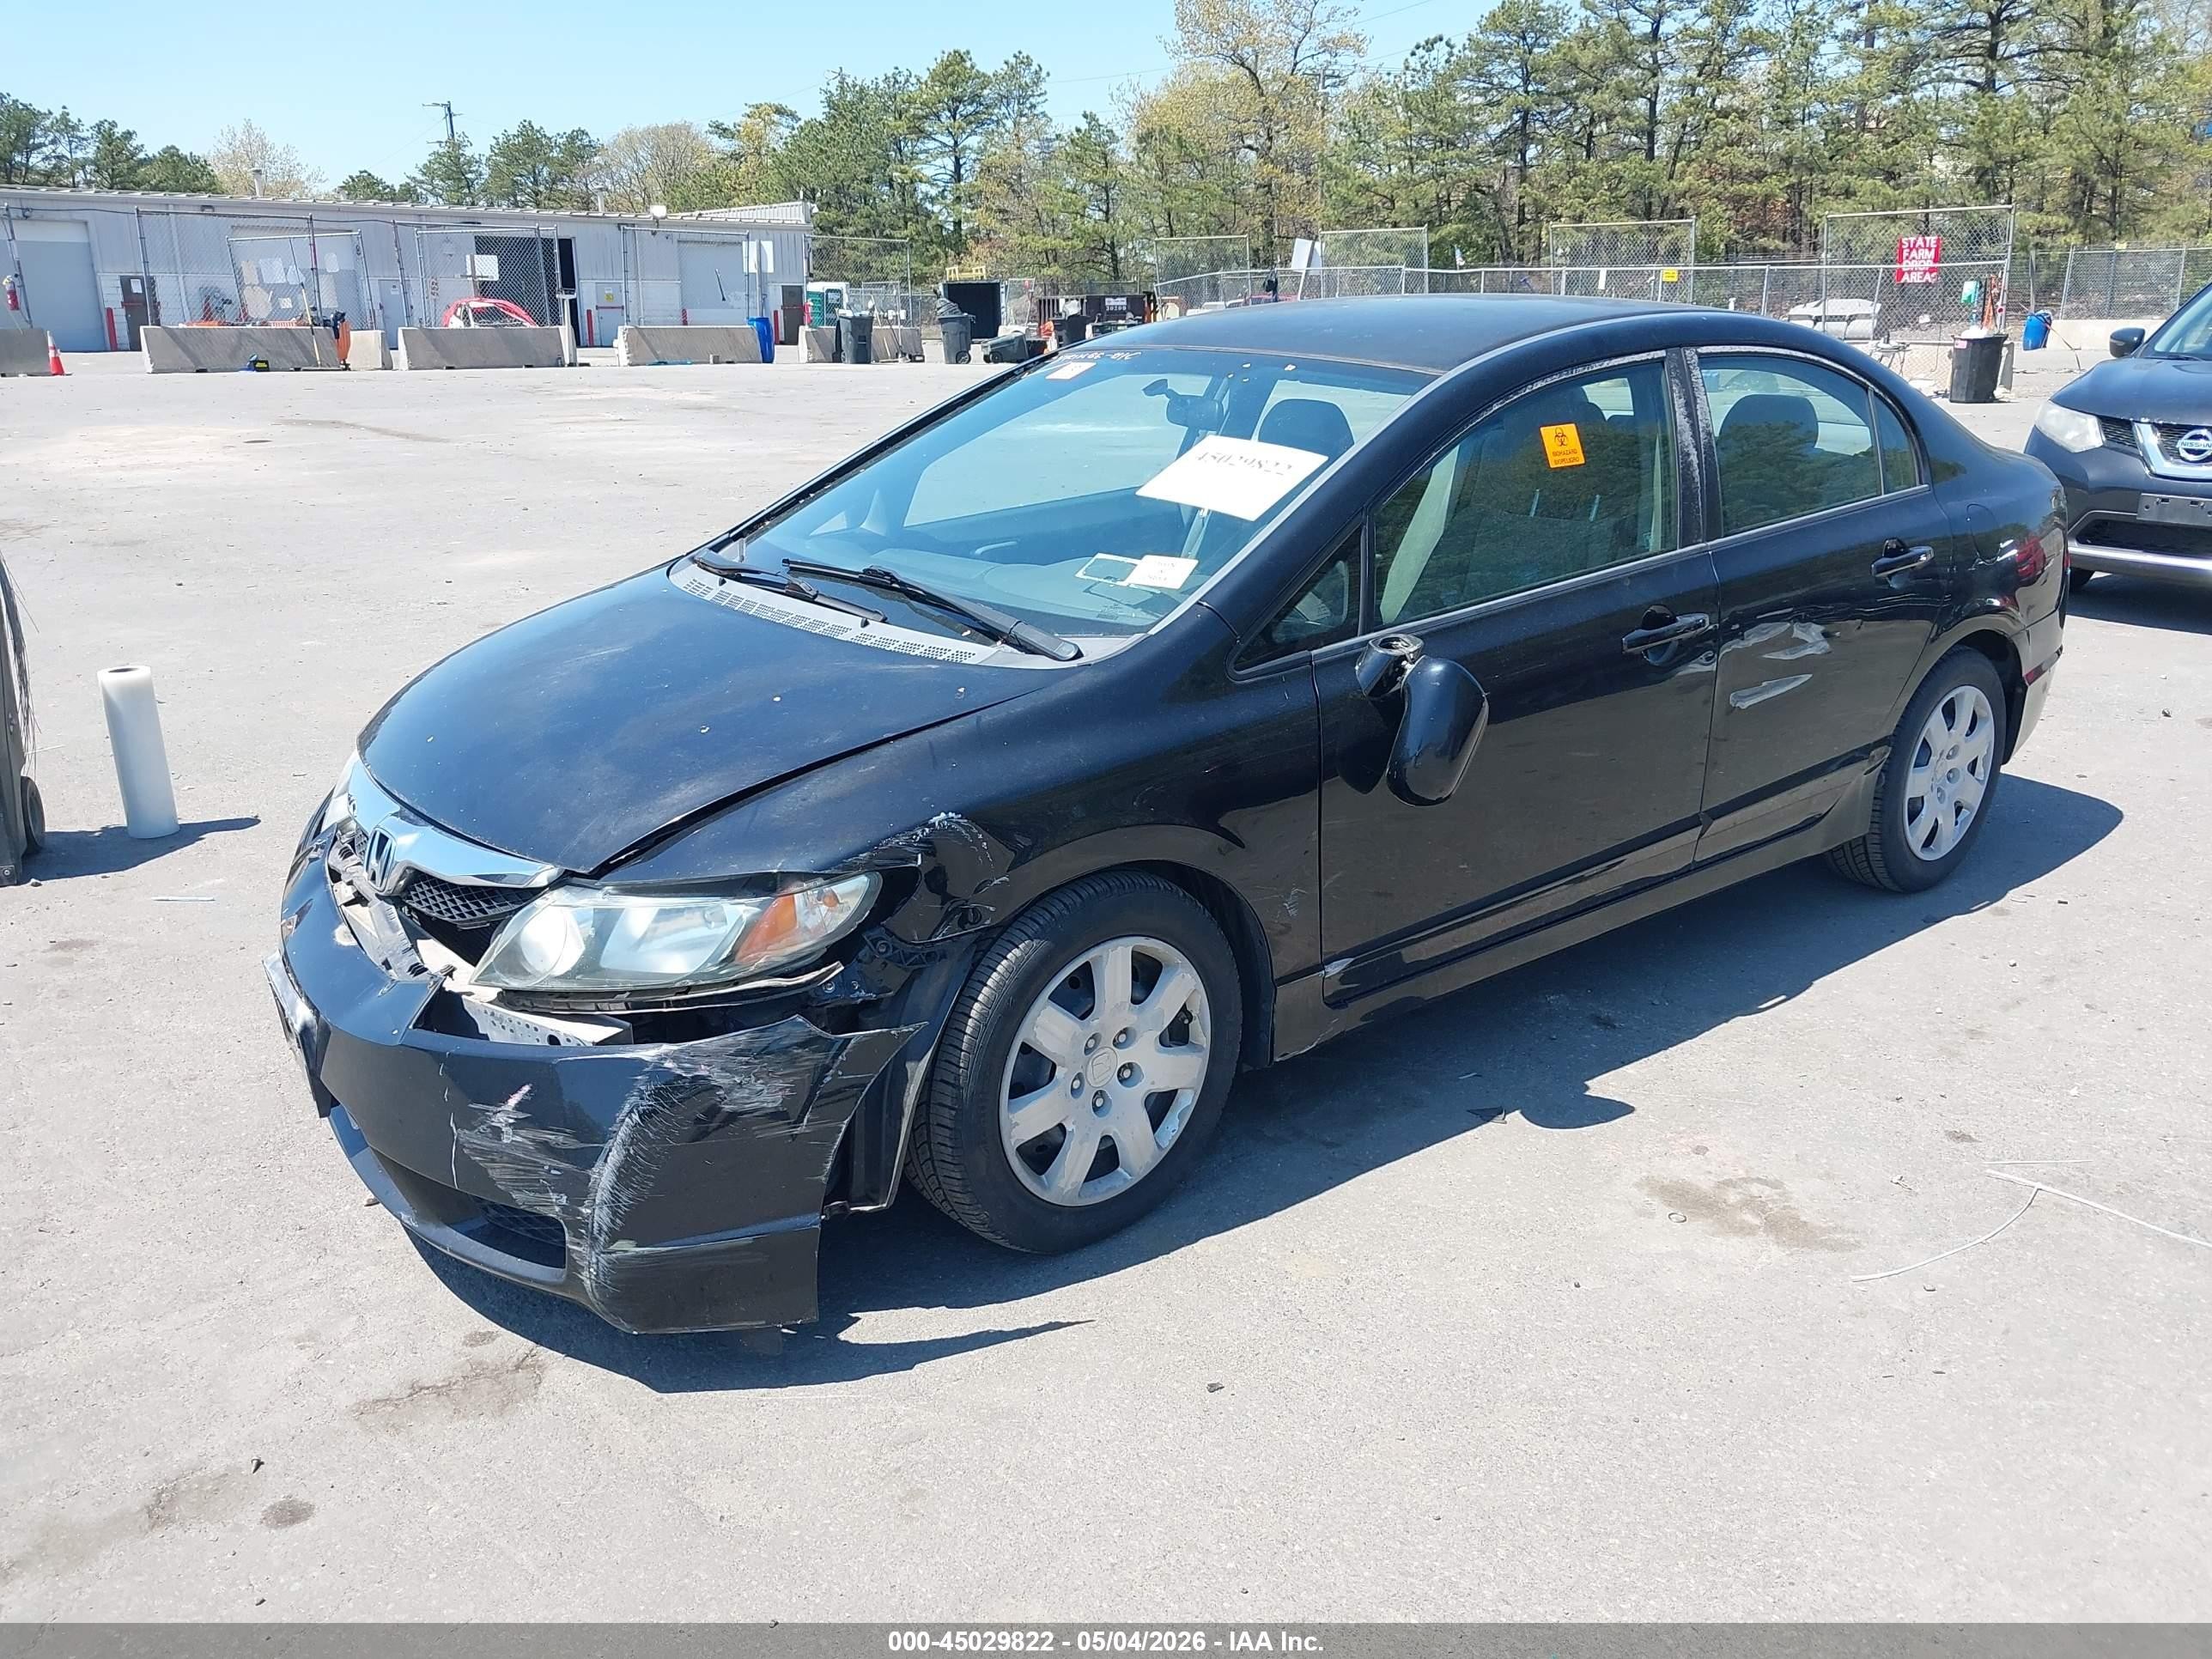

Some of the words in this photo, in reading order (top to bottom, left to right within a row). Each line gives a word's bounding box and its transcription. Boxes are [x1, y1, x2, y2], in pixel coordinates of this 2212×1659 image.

[1901, 236, 1937, 248] STATE
[1902, 248, 1936, 260] FARM
[1902, 259, 1933, 270] DROP
